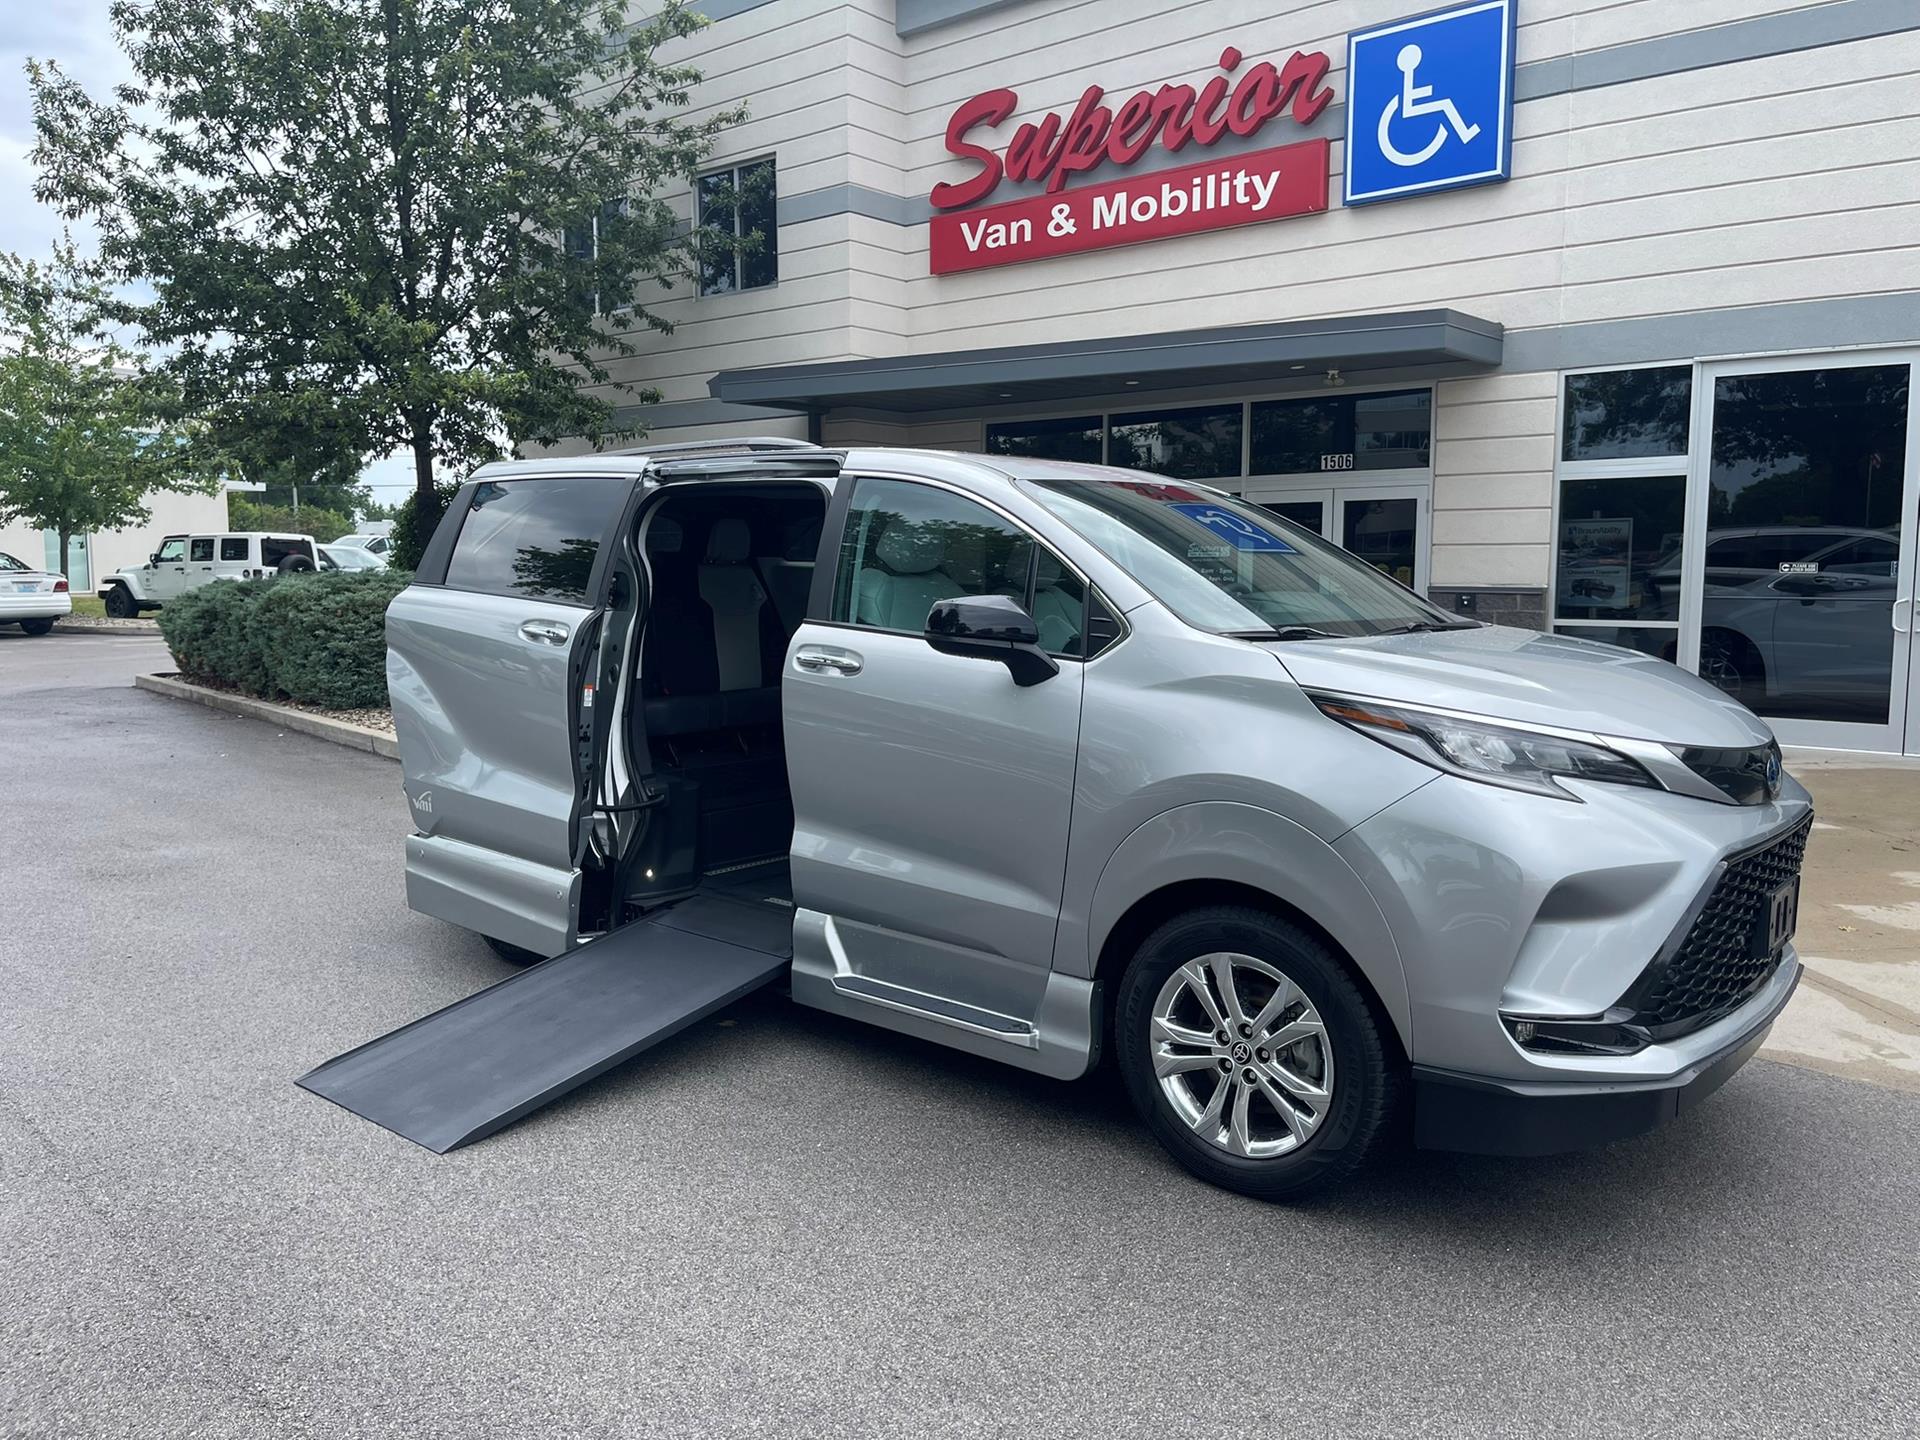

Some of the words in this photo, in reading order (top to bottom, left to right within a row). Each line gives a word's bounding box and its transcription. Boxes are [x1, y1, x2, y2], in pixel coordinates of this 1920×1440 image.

[930, 46, 1333, 208] Superior
[960, 218, 1032, 253] Van
[1047, 203, 1077, 237] &
[1093, 170, 1281, 231] Mobility
[1323, 455, 1352, 469] 1506
